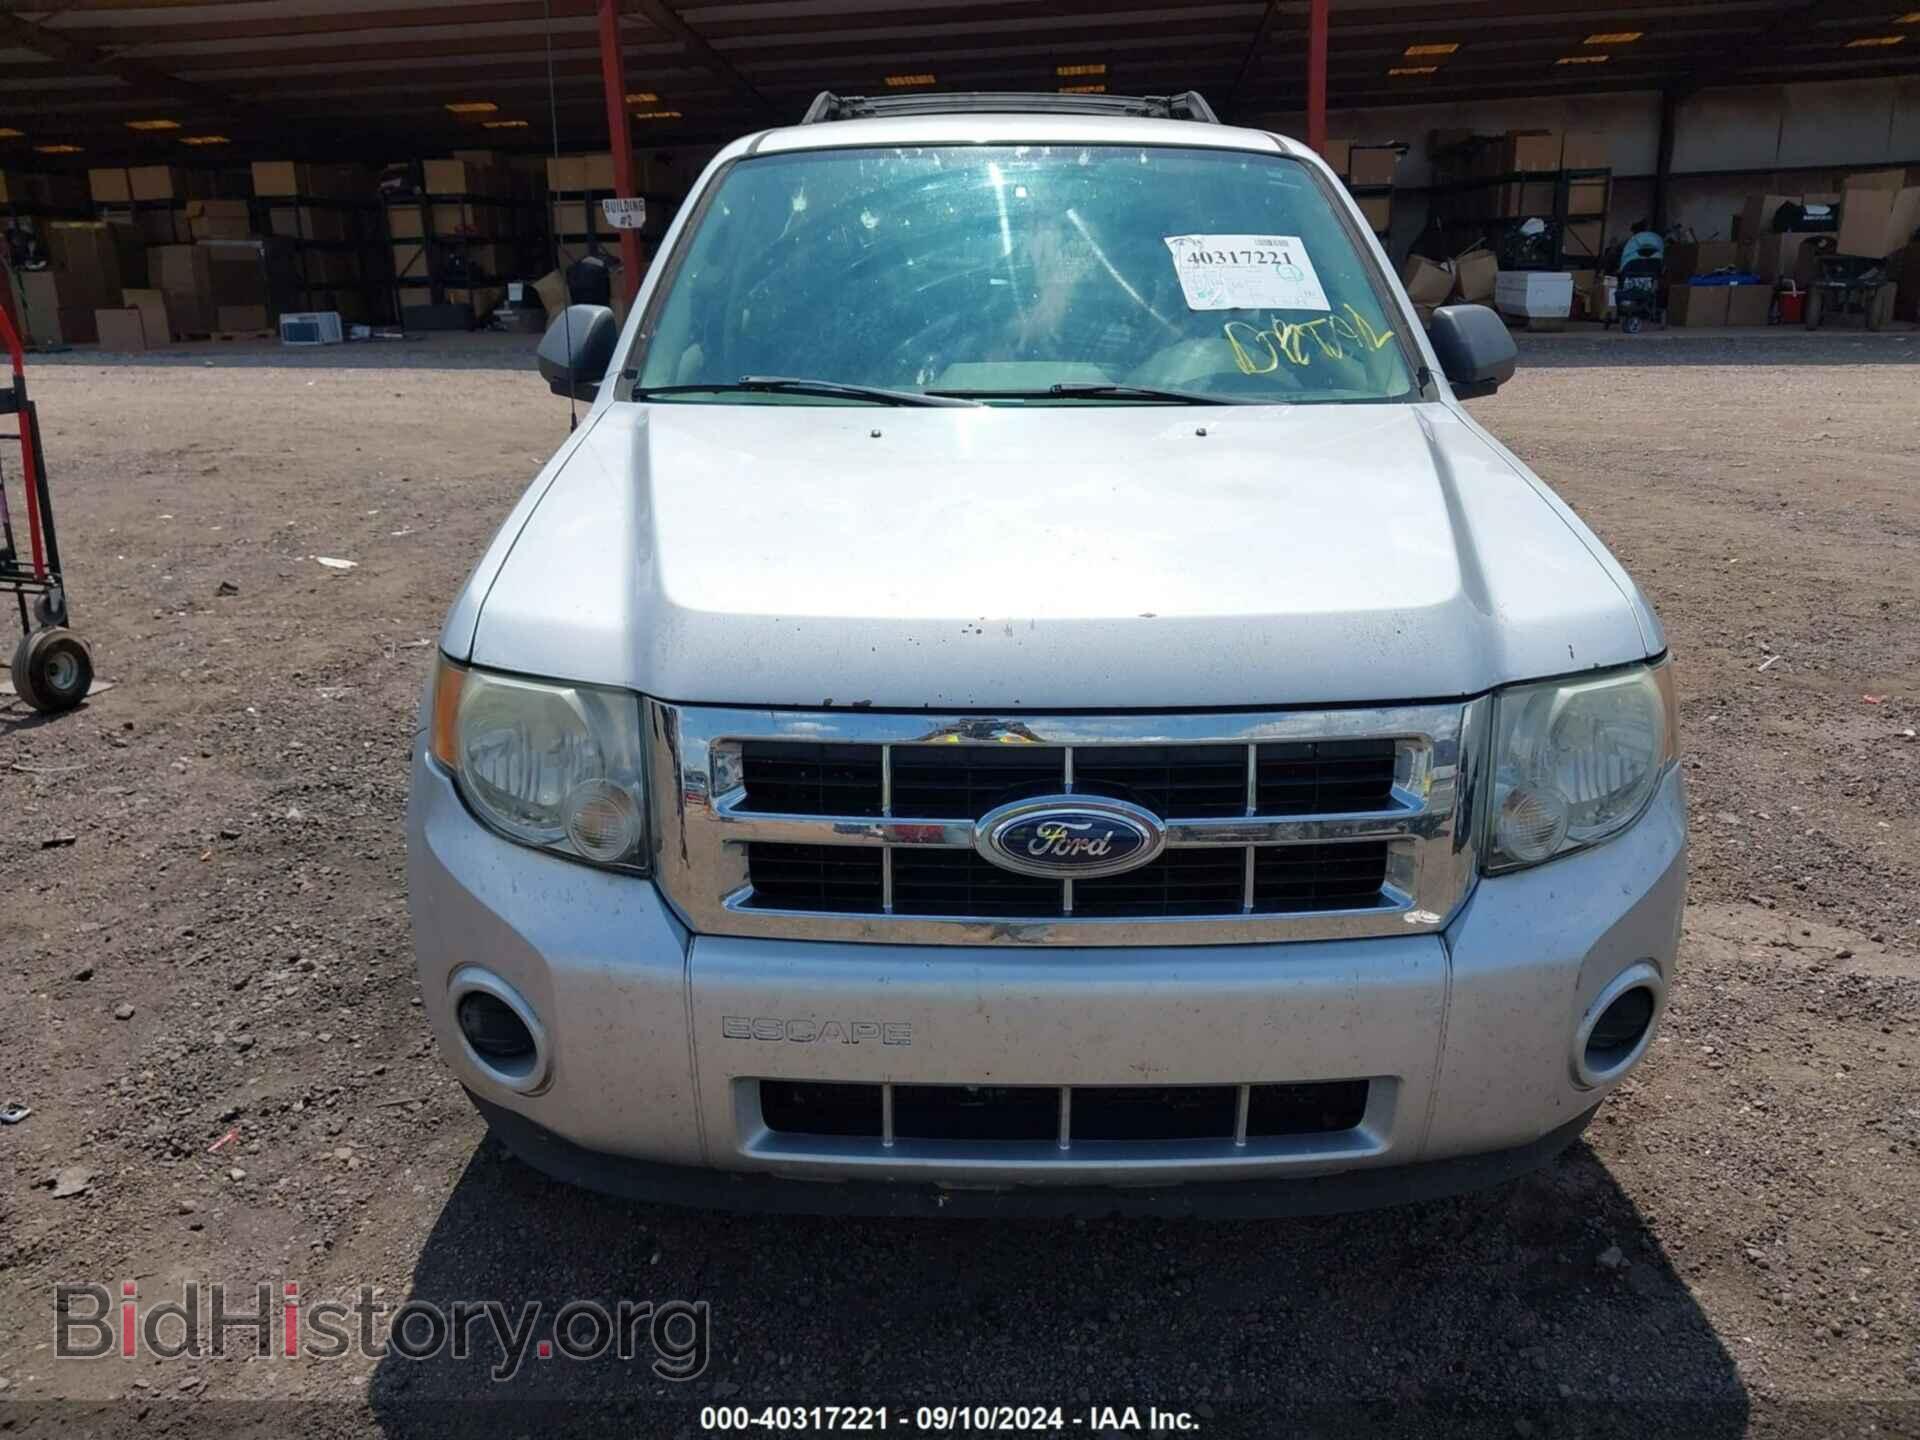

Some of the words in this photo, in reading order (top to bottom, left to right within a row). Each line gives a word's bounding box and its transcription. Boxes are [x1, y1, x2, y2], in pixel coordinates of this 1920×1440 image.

[604, 200, 643, 213] BUILDING
[1187, 250, 1293, 265] 40317221
[1027, 820, 1113, 856] Ford
[721, 1015, 912, 1045] ESCAPE
